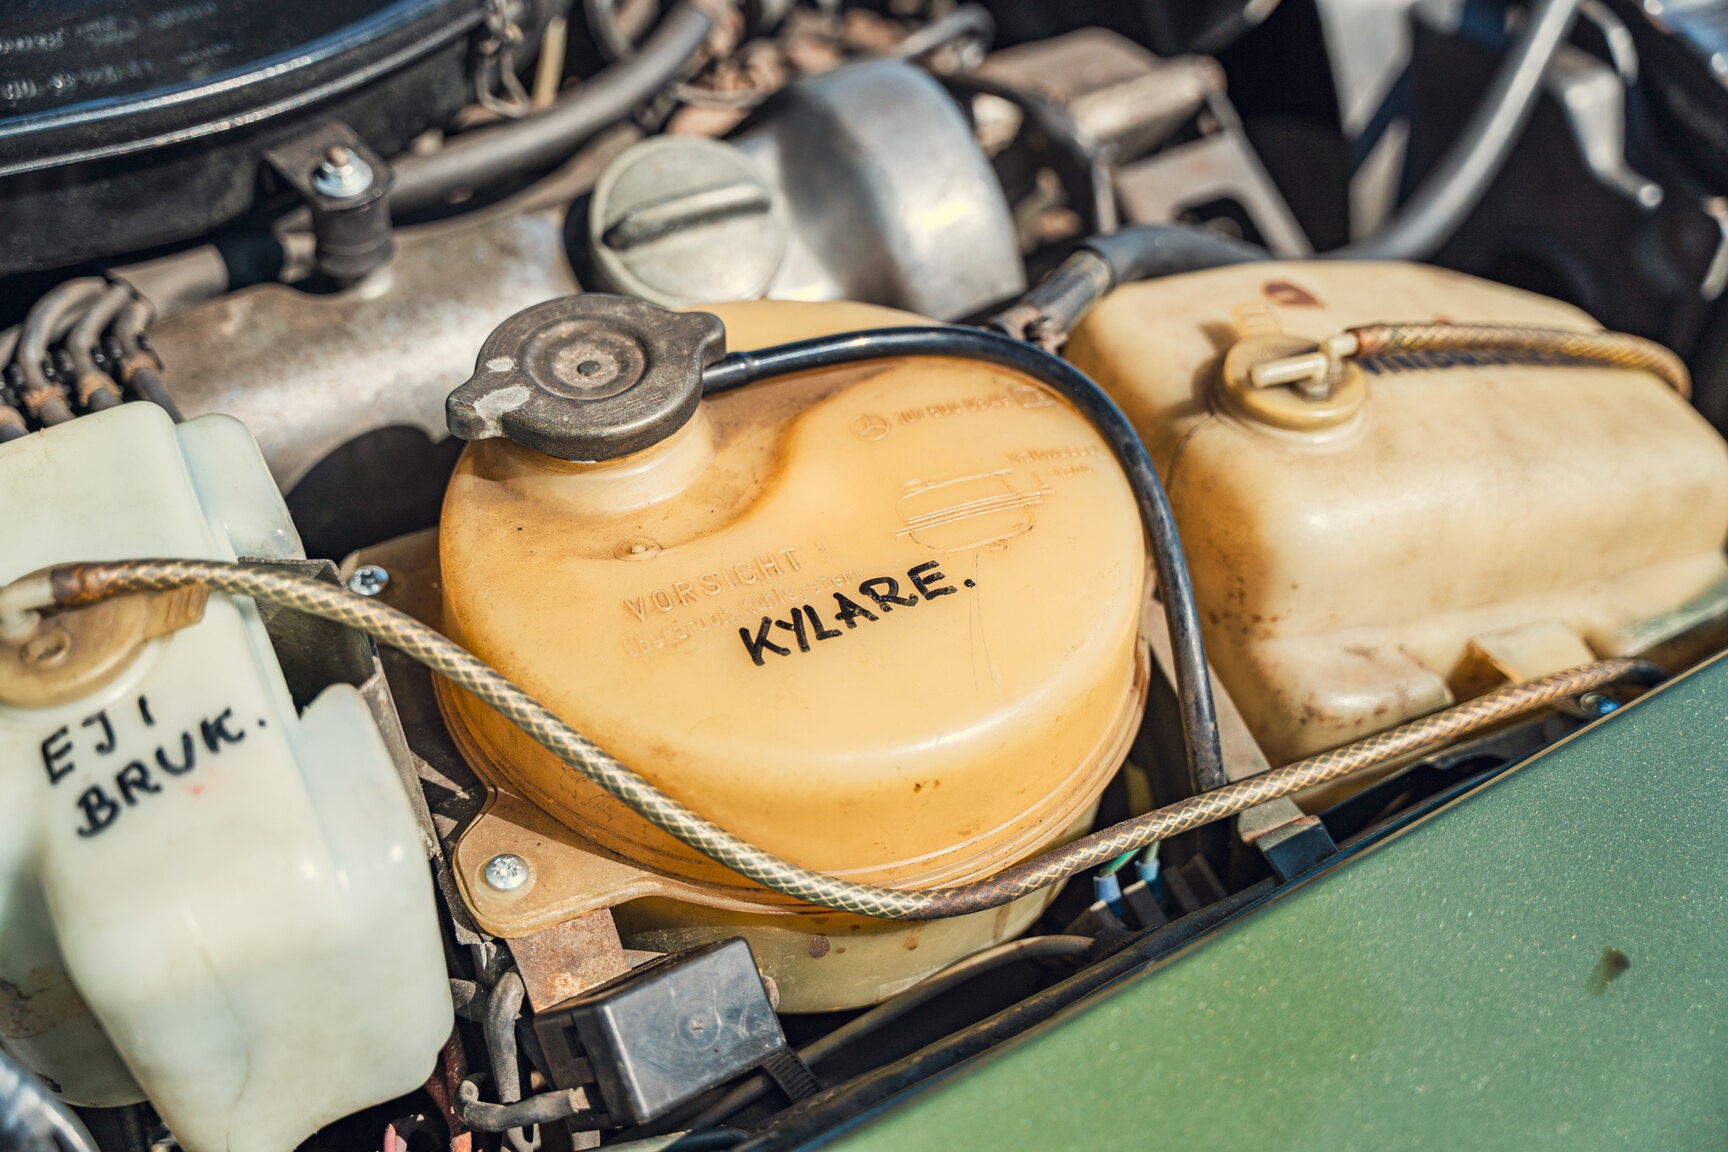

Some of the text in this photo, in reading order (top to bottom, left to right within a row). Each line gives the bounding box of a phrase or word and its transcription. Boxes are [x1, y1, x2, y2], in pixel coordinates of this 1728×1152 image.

[623, 546, 801, 623] VORSICHT
[738, 559, 977, 667] KYLARE.
[40, 709, 117, 786] EJ
[76, 705, 268, 839] BRUK.
